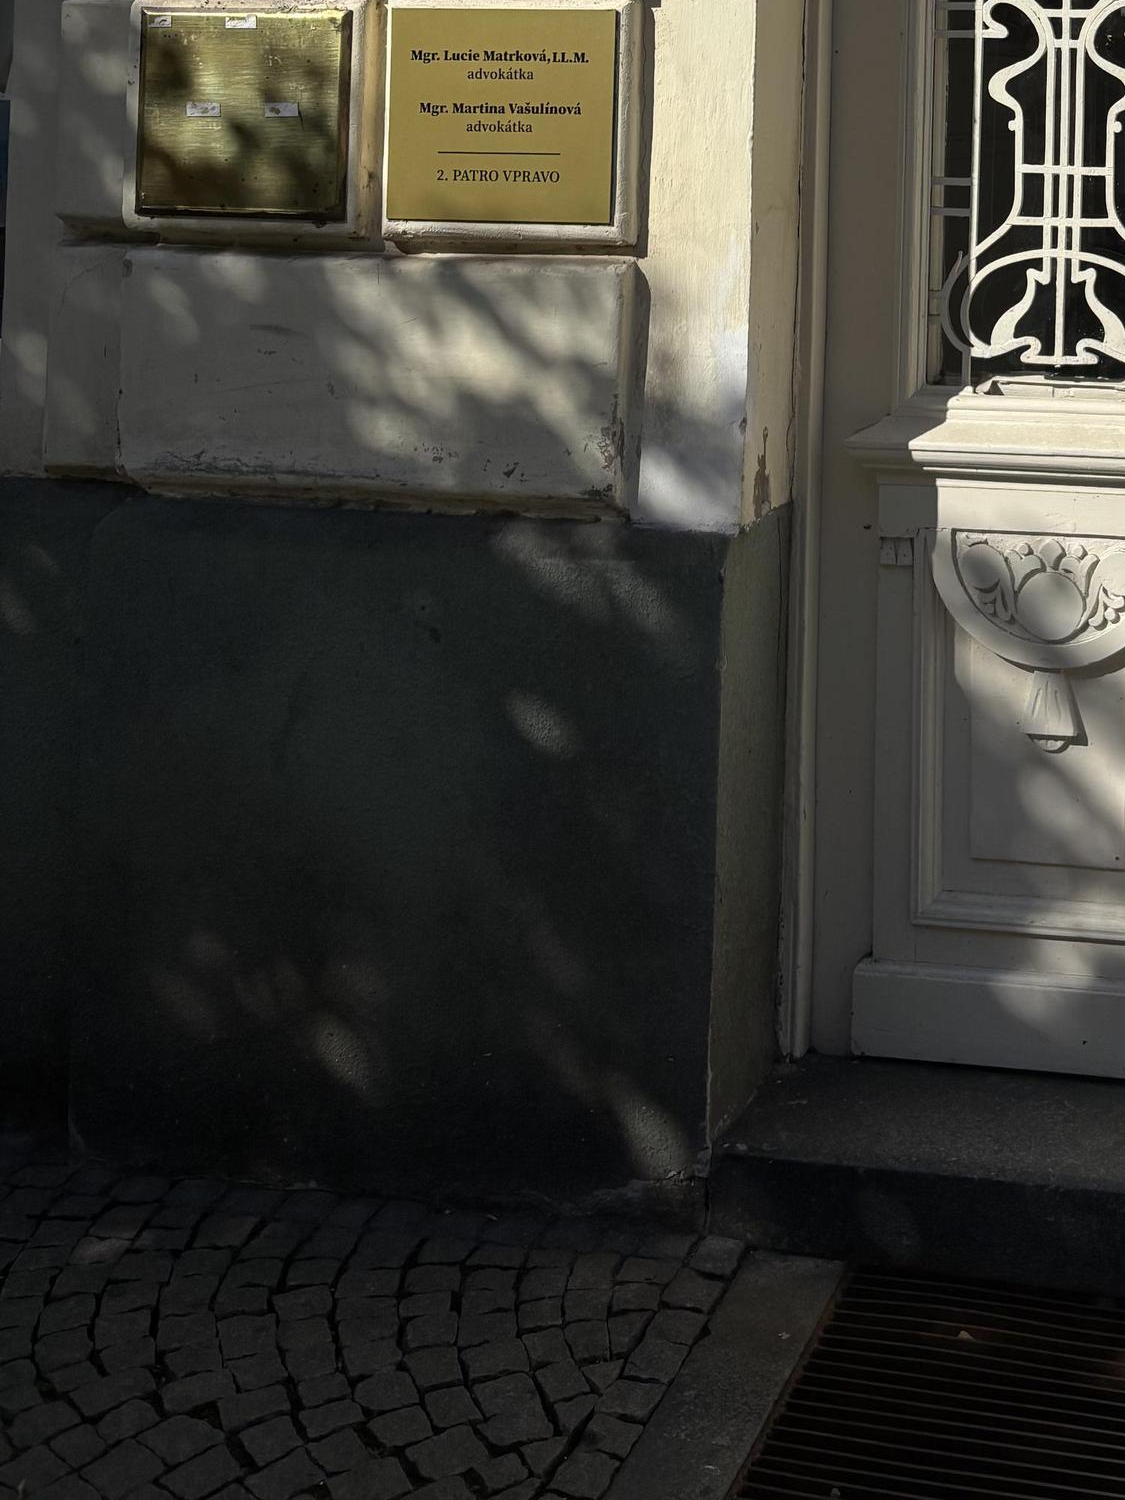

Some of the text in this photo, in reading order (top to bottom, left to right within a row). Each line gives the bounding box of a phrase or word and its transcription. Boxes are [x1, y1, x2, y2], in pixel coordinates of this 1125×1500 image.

[411, 50, 440, 63] Mgr.
[444, 49, 479, 61] Lucie
[468, 67, 533, 79] advokátka
[420, 102, 581, 116] Mgr. Martina Vašulínová
[466, 120, 532, 132] advokátka
[437, 170, 559, 182] 2. PATRO VPRAVO
